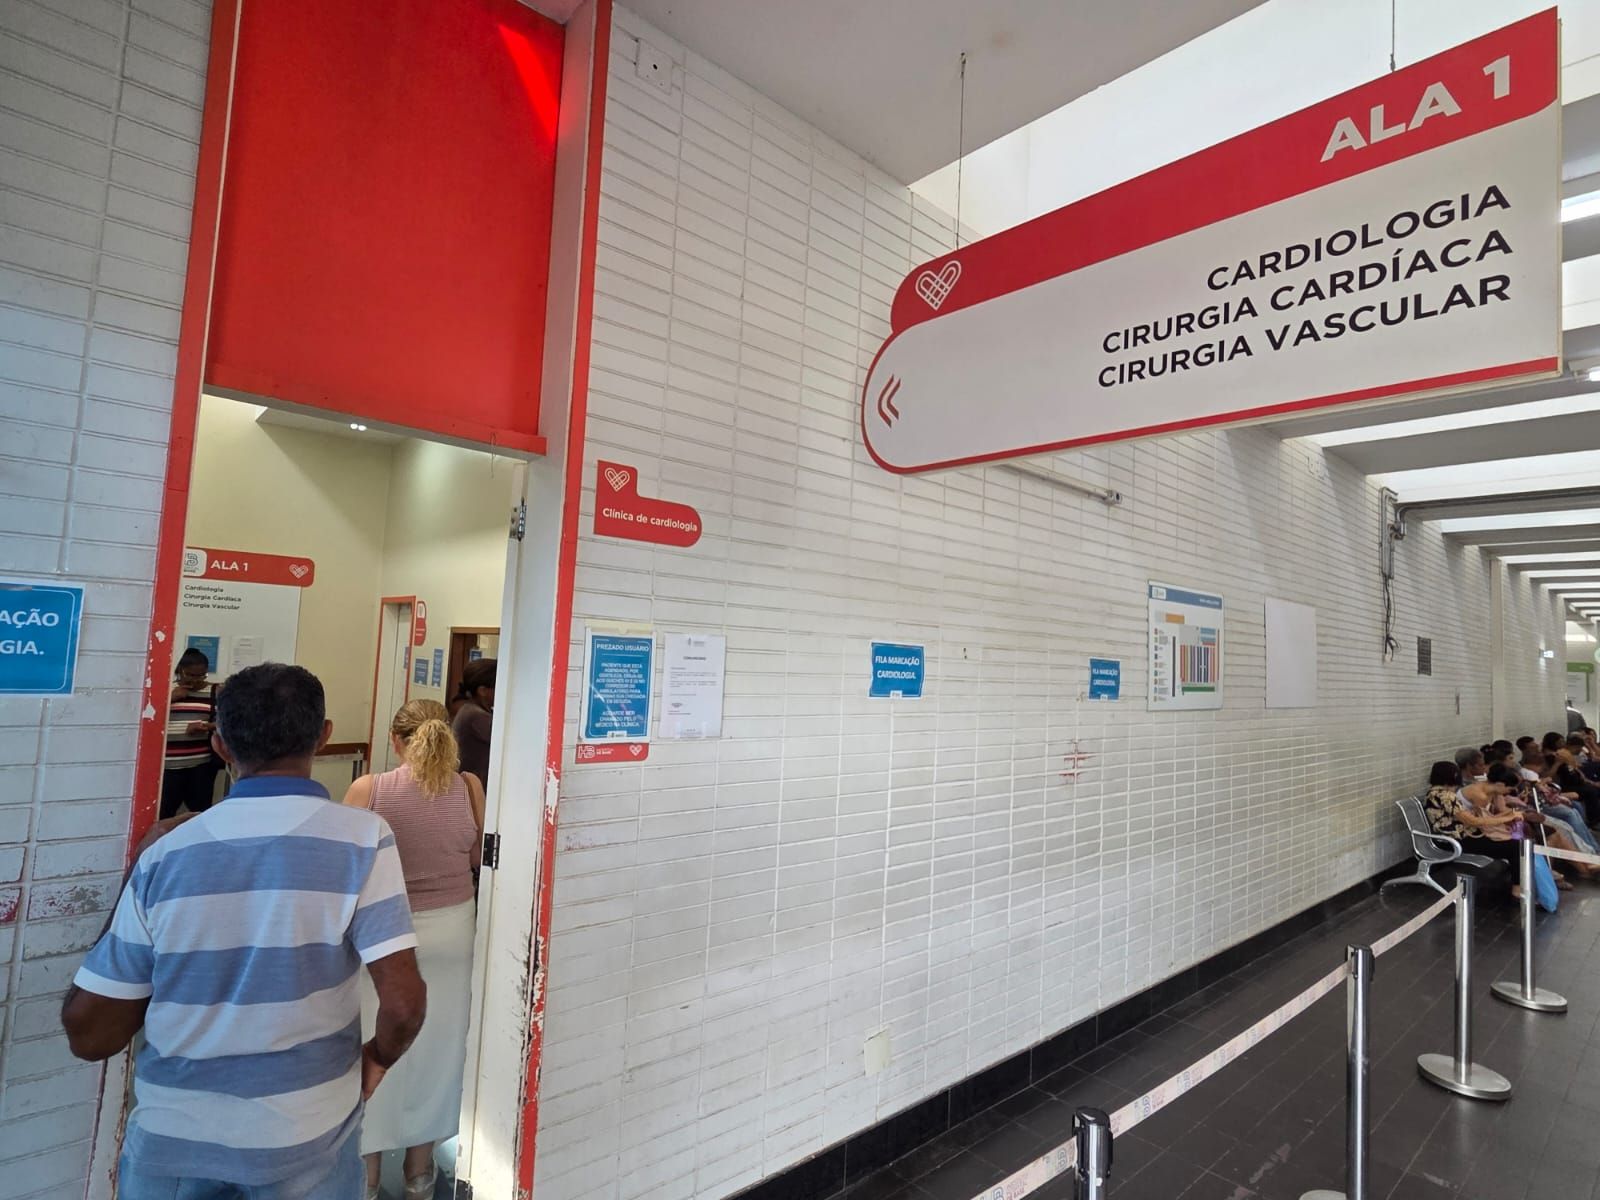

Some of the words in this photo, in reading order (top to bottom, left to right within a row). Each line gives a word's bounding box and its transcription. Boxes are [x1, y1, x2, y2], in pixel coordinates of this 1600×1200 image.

[1320, 81, 1462, 163] ALA
[1482, 55, 1510, 100] 1
[1207, 184, 1511, 291] CARDIOLOGIA
[1102, 296, 1258, 353] CIRURGIA
[1270, 229, 1513, 311] CARDÍACA
[1098, 335, 1253, 387] CIRURGIA
[1265, 274, 1511, 351] VASCULAR
[602, 507, 634, 521] Clínica
[636, 513, 648, 524] de
[650, 517, 698, 532] cardiologia
[211, 560, 239, 570] ALA
[243, 562, 249, 571] 1
[596, 643, 624, 651] PREZADO
[875, 655, 888, 664] FILA
[888, 656, 920, 667] MARCAÇÃO
